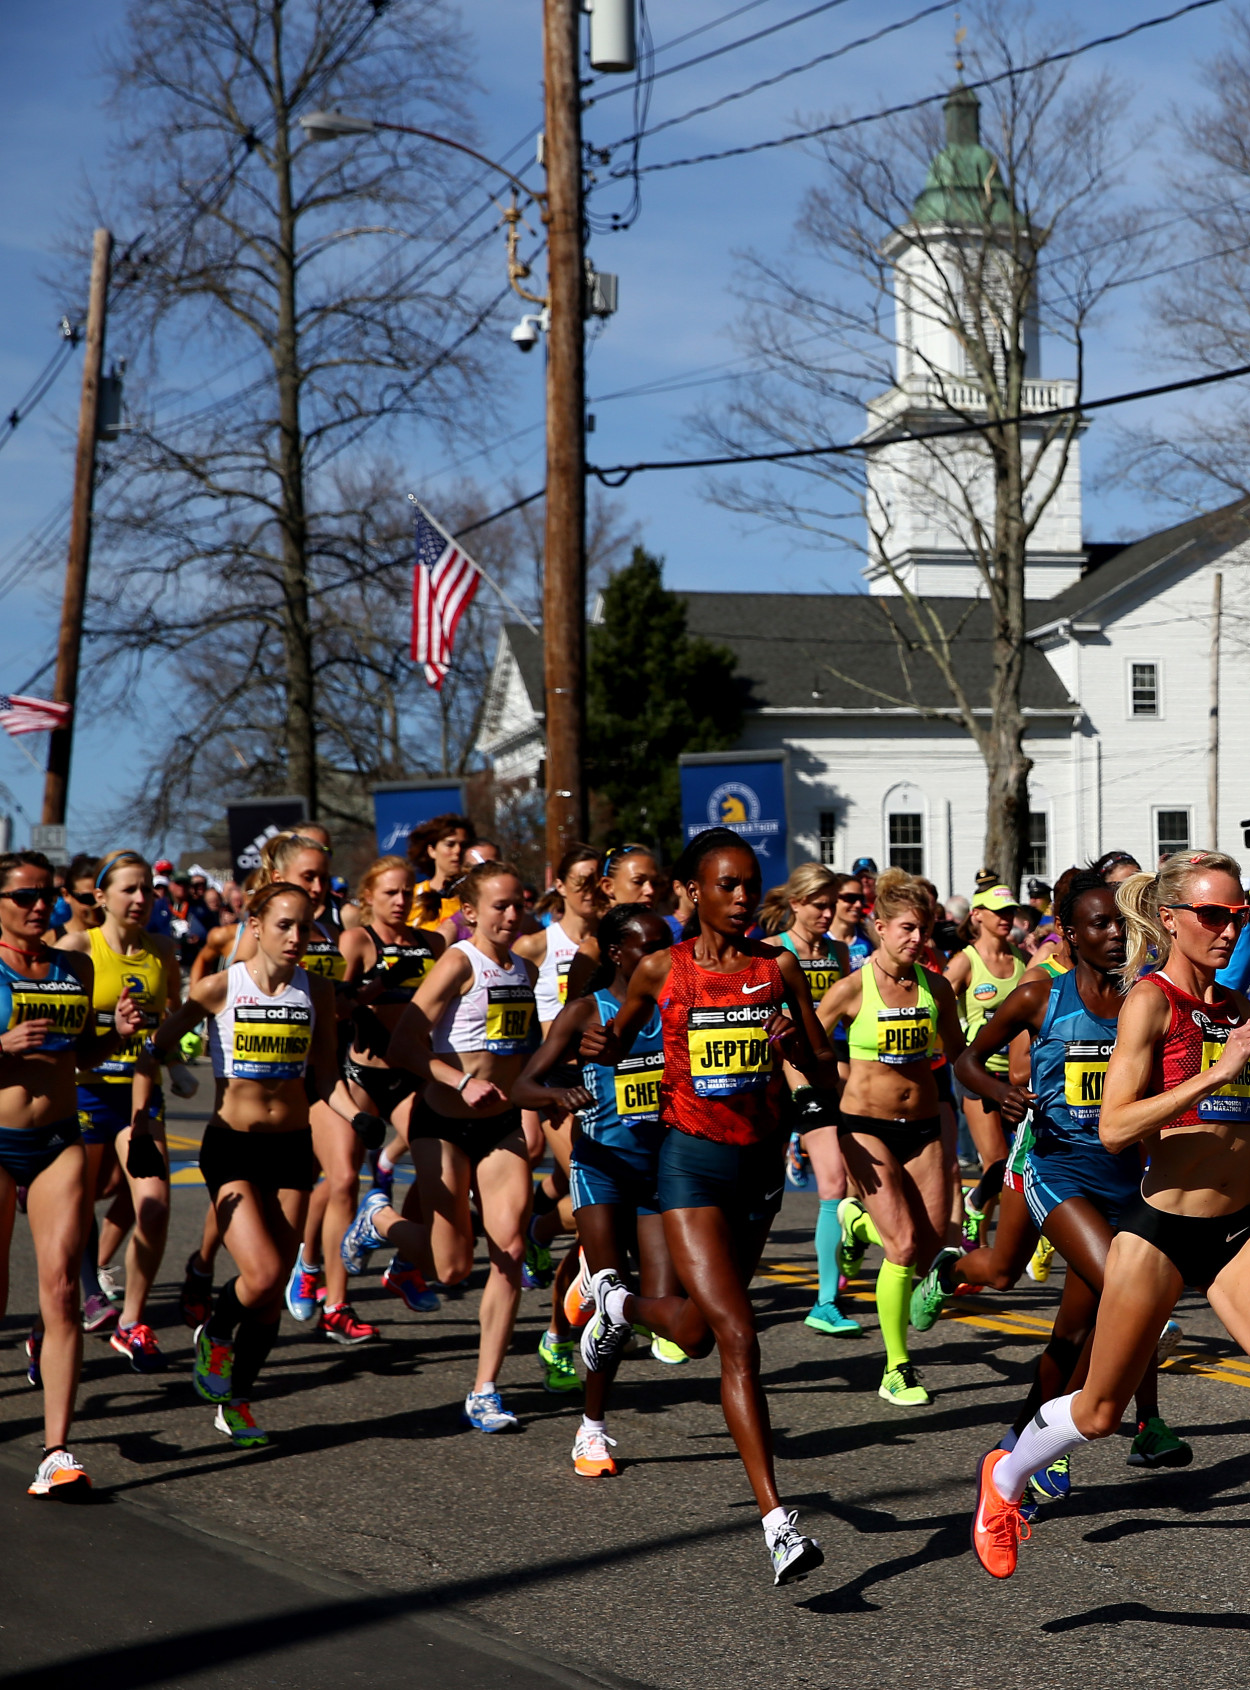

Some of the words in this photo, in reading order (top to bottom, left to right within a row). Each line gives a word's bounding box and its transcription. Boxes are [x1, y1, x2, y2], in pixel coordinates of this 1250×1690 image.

[313, 957, 335, 976] 42
[15, 1002, 87, 1029] THOMAS
[235, 1034, 309, 1054] CUMMINGS
[886, 1026, 929, 1051] PIERS
[700, 1038, 771, 1069] JEPTOO
